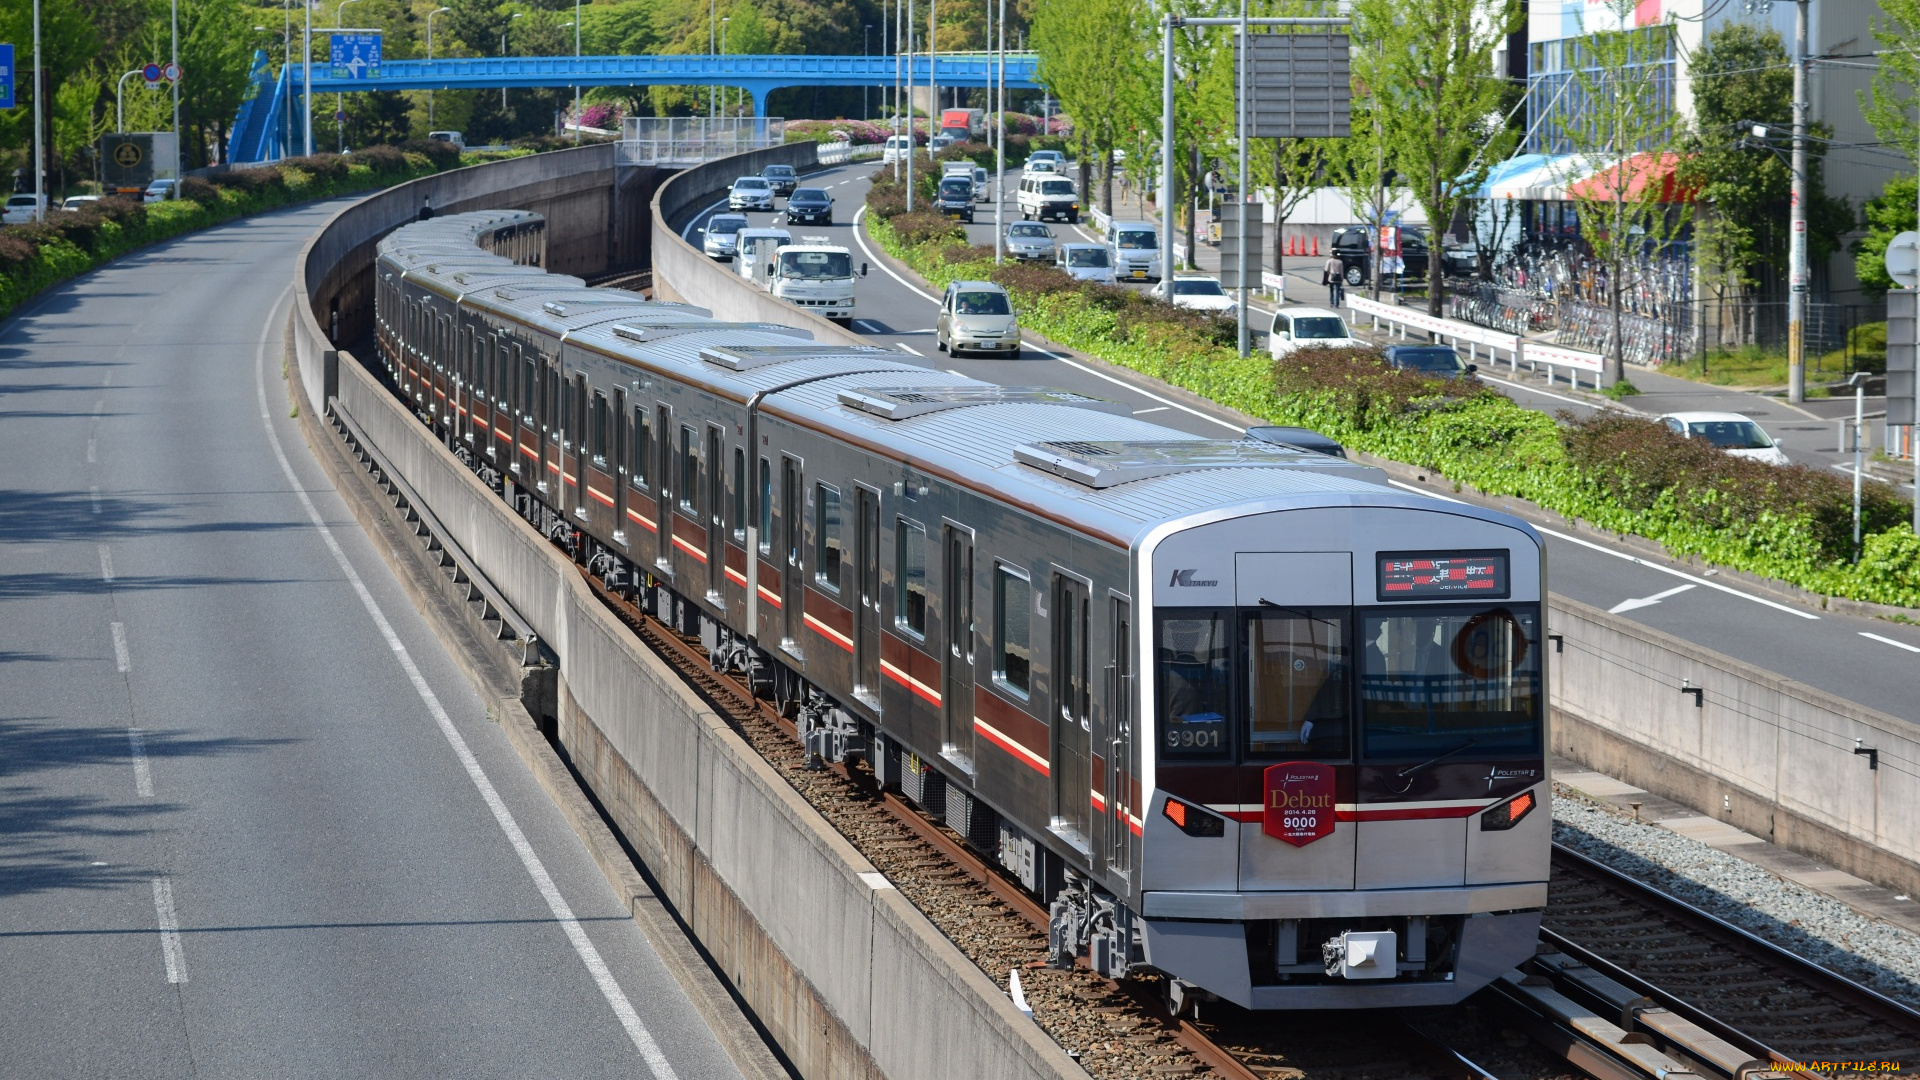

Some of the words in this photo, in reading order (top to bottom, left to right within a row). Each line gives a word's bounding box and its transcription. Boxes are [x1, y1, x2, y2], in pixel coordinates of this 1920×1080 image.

[1169, 568, 1218, 587] KITAKYU
[1167, 730, 1218, 747] 9901
[1270, 789, 1331, 808] Debut
[1283, 817, 1317, 828] 9000
